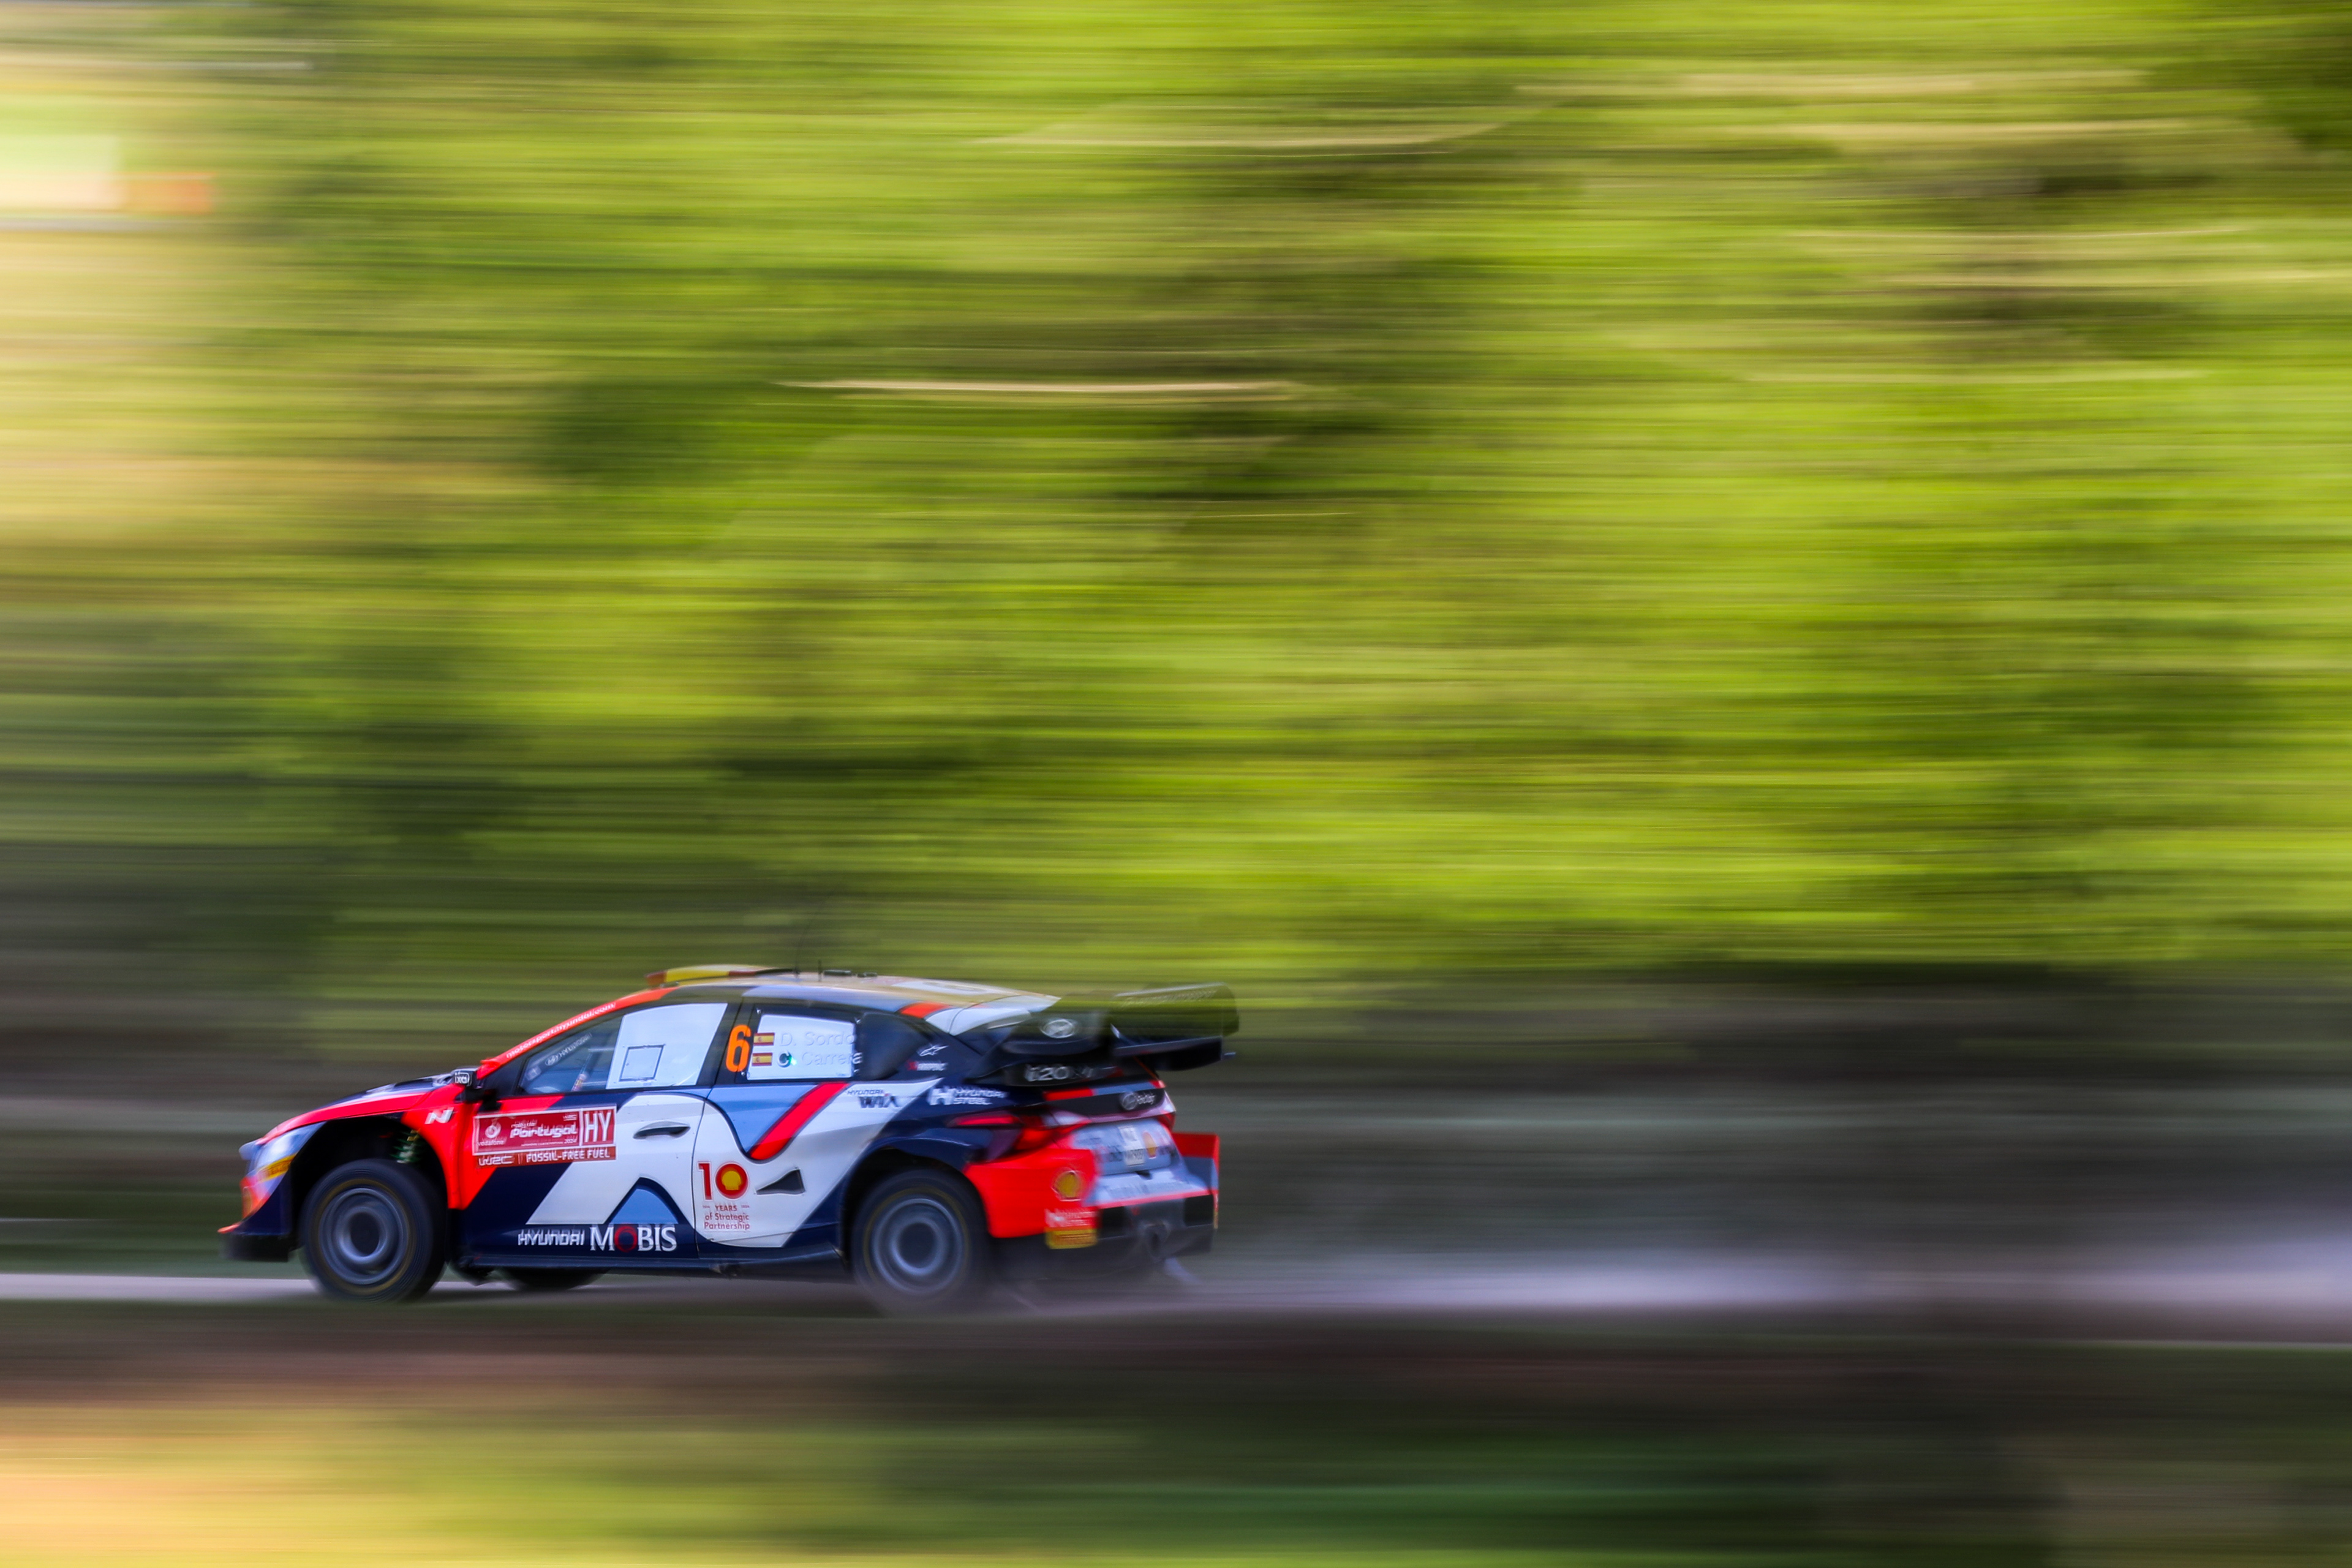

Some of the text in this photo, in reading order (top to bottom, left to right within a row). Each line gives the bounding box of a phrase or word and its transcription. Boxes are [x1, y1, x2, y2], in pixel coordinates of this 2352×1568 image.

[805, 1031, 855, 1046] Sordo
[725, 1024, 752, 1072] 6
[802, 1051, 862, 1066] Carrera
[858, 1095, 900, 1109] WIA
[510, 1121, 578, 1139] Portugal
[584, 1109, 612, 1143] HY
[479, 1155, 513, 1166] WRC
[526, 1148, 610, 1163] FOSSIL-FREE FUEL
[714, 1212, 749, 1222] Strategic
[704, 1221, 750, 1231] Partnership
[518, 1224, 677, 1253] HYUNDAI MOBIS
